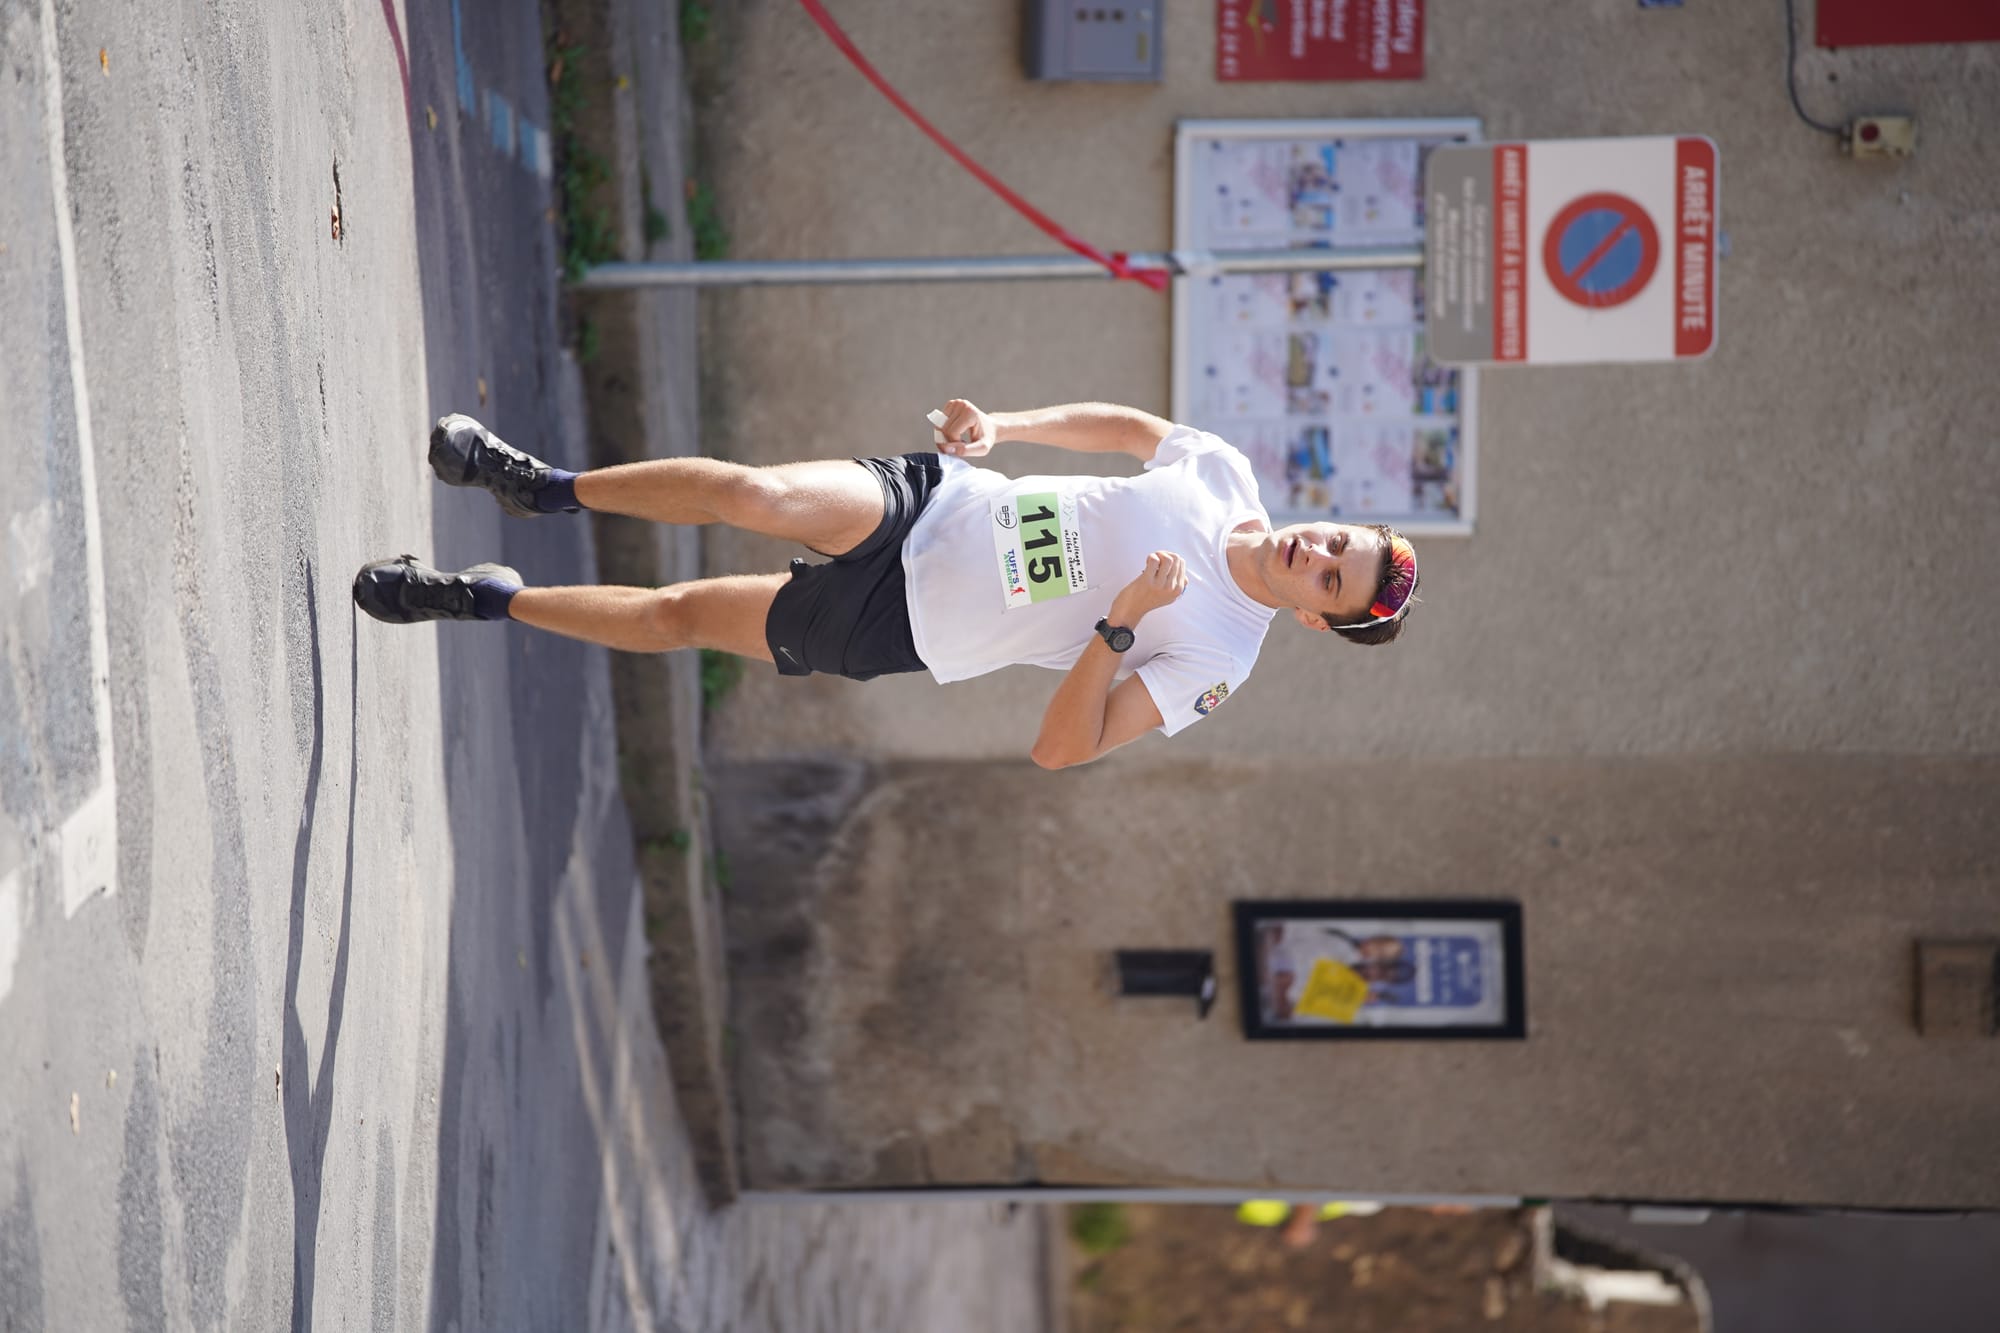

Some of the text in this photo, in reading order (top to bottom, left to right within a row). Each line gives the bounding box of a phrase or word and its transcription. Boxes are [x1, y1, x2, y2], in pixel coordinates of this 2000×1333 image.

[1503, 150, 1523, 197] ARRÊT
[1503, 200, 1523, 250] LIMITÉ
[1682, 166, 1710, 330] ARRÊT MINUTE
[1503, 253, 1523, 265] À
[1503, 289, 1520, 358] MINUTES
[1001, 505, 1011, 526] BFP
[1007, 549, 1020, 584] TUFF'S
[1021, 505, 1063, 584] 115
[1072, 531, 1081, 566] Challenge
